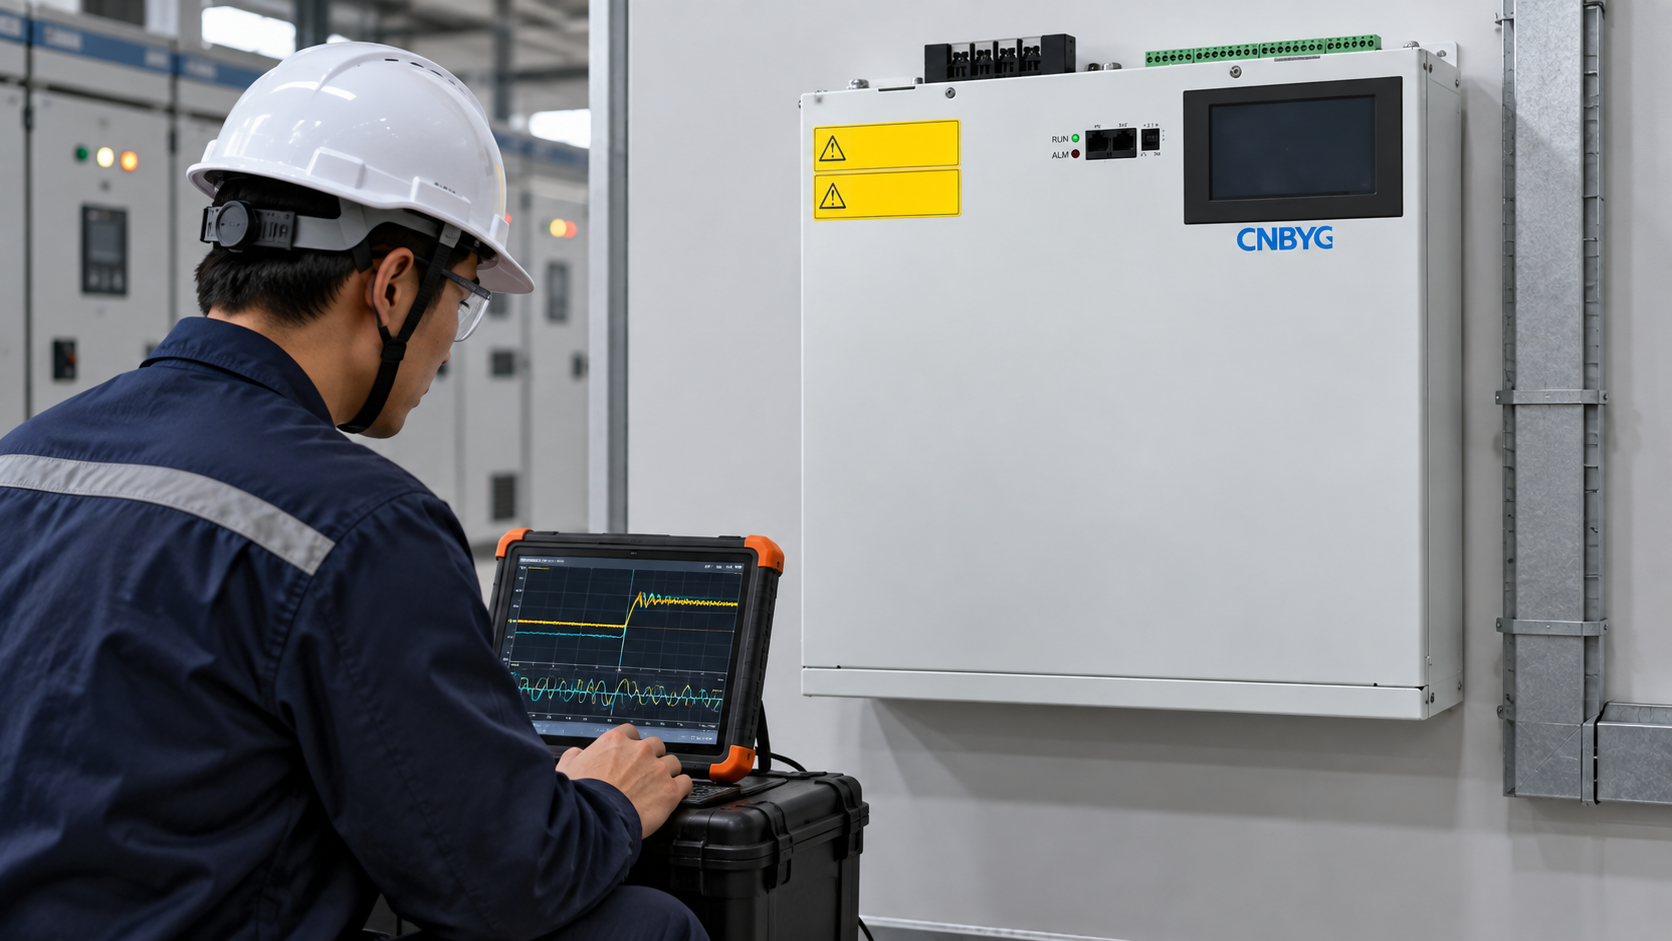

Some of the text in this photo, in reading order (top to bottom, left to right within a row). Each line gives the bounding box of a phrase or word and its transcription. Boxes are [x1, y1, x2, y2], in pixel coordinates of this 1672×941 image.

[1051, 135, 1069, 144] RUN
[1051, 150, 1070, 160] ALM
[1236, 225, 1334, 252] CNBYG
